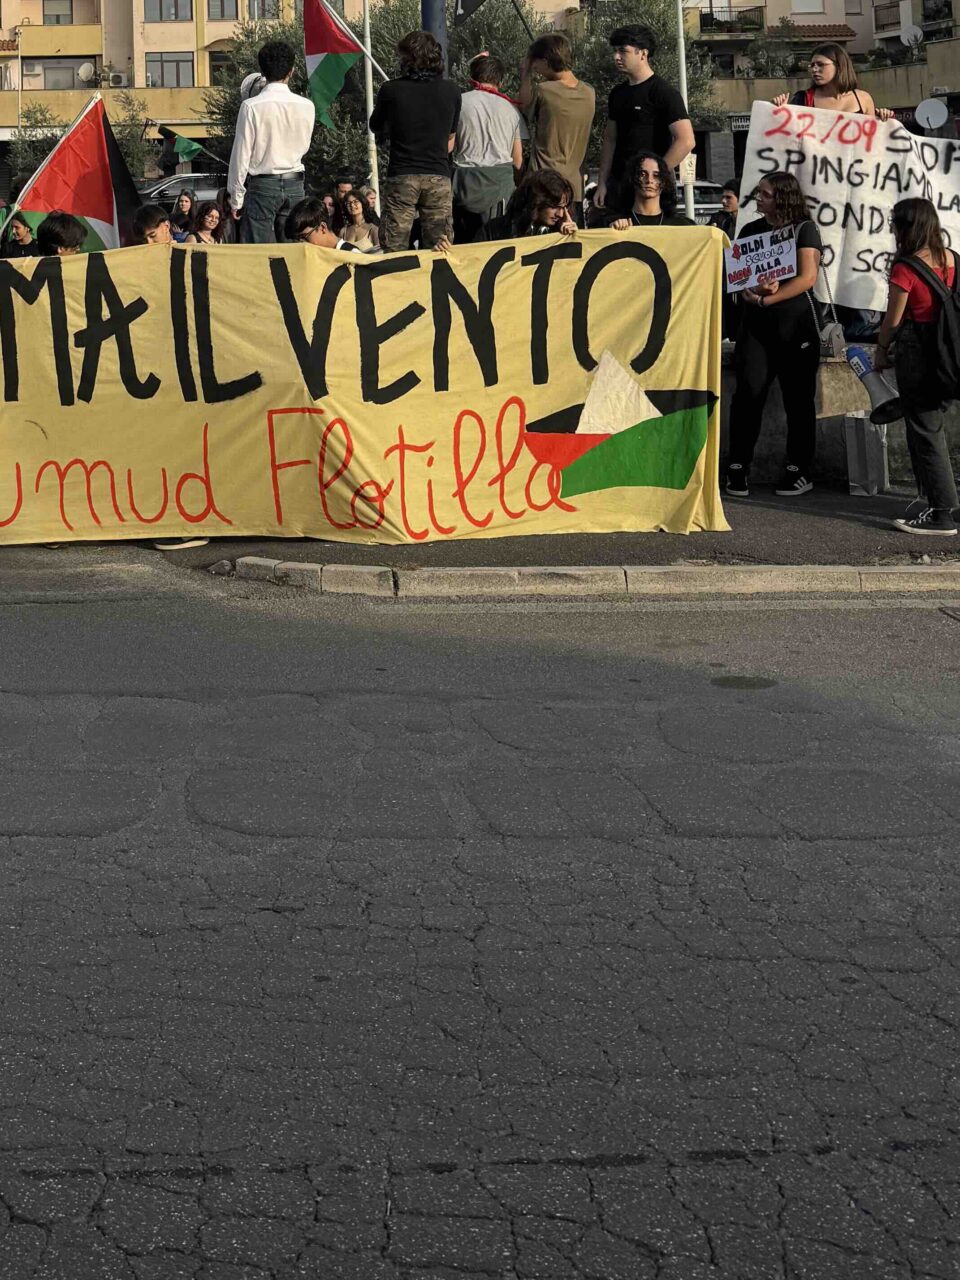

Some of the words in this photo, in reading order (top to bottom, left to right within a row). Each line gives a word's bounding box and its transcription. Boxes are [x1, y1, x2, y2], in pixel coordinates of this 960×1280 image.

[764, 107, 878, 152] 22/09
[728, 265, 752, 284] NON
[755, 258, 781, 275] ALLA
[745, 245, 784, 266] SCUOLA
[170, 248, 265, 404] IL
[268, 240, 672, 405] VENTO
[266, 396, 579, 540] Flotilla
